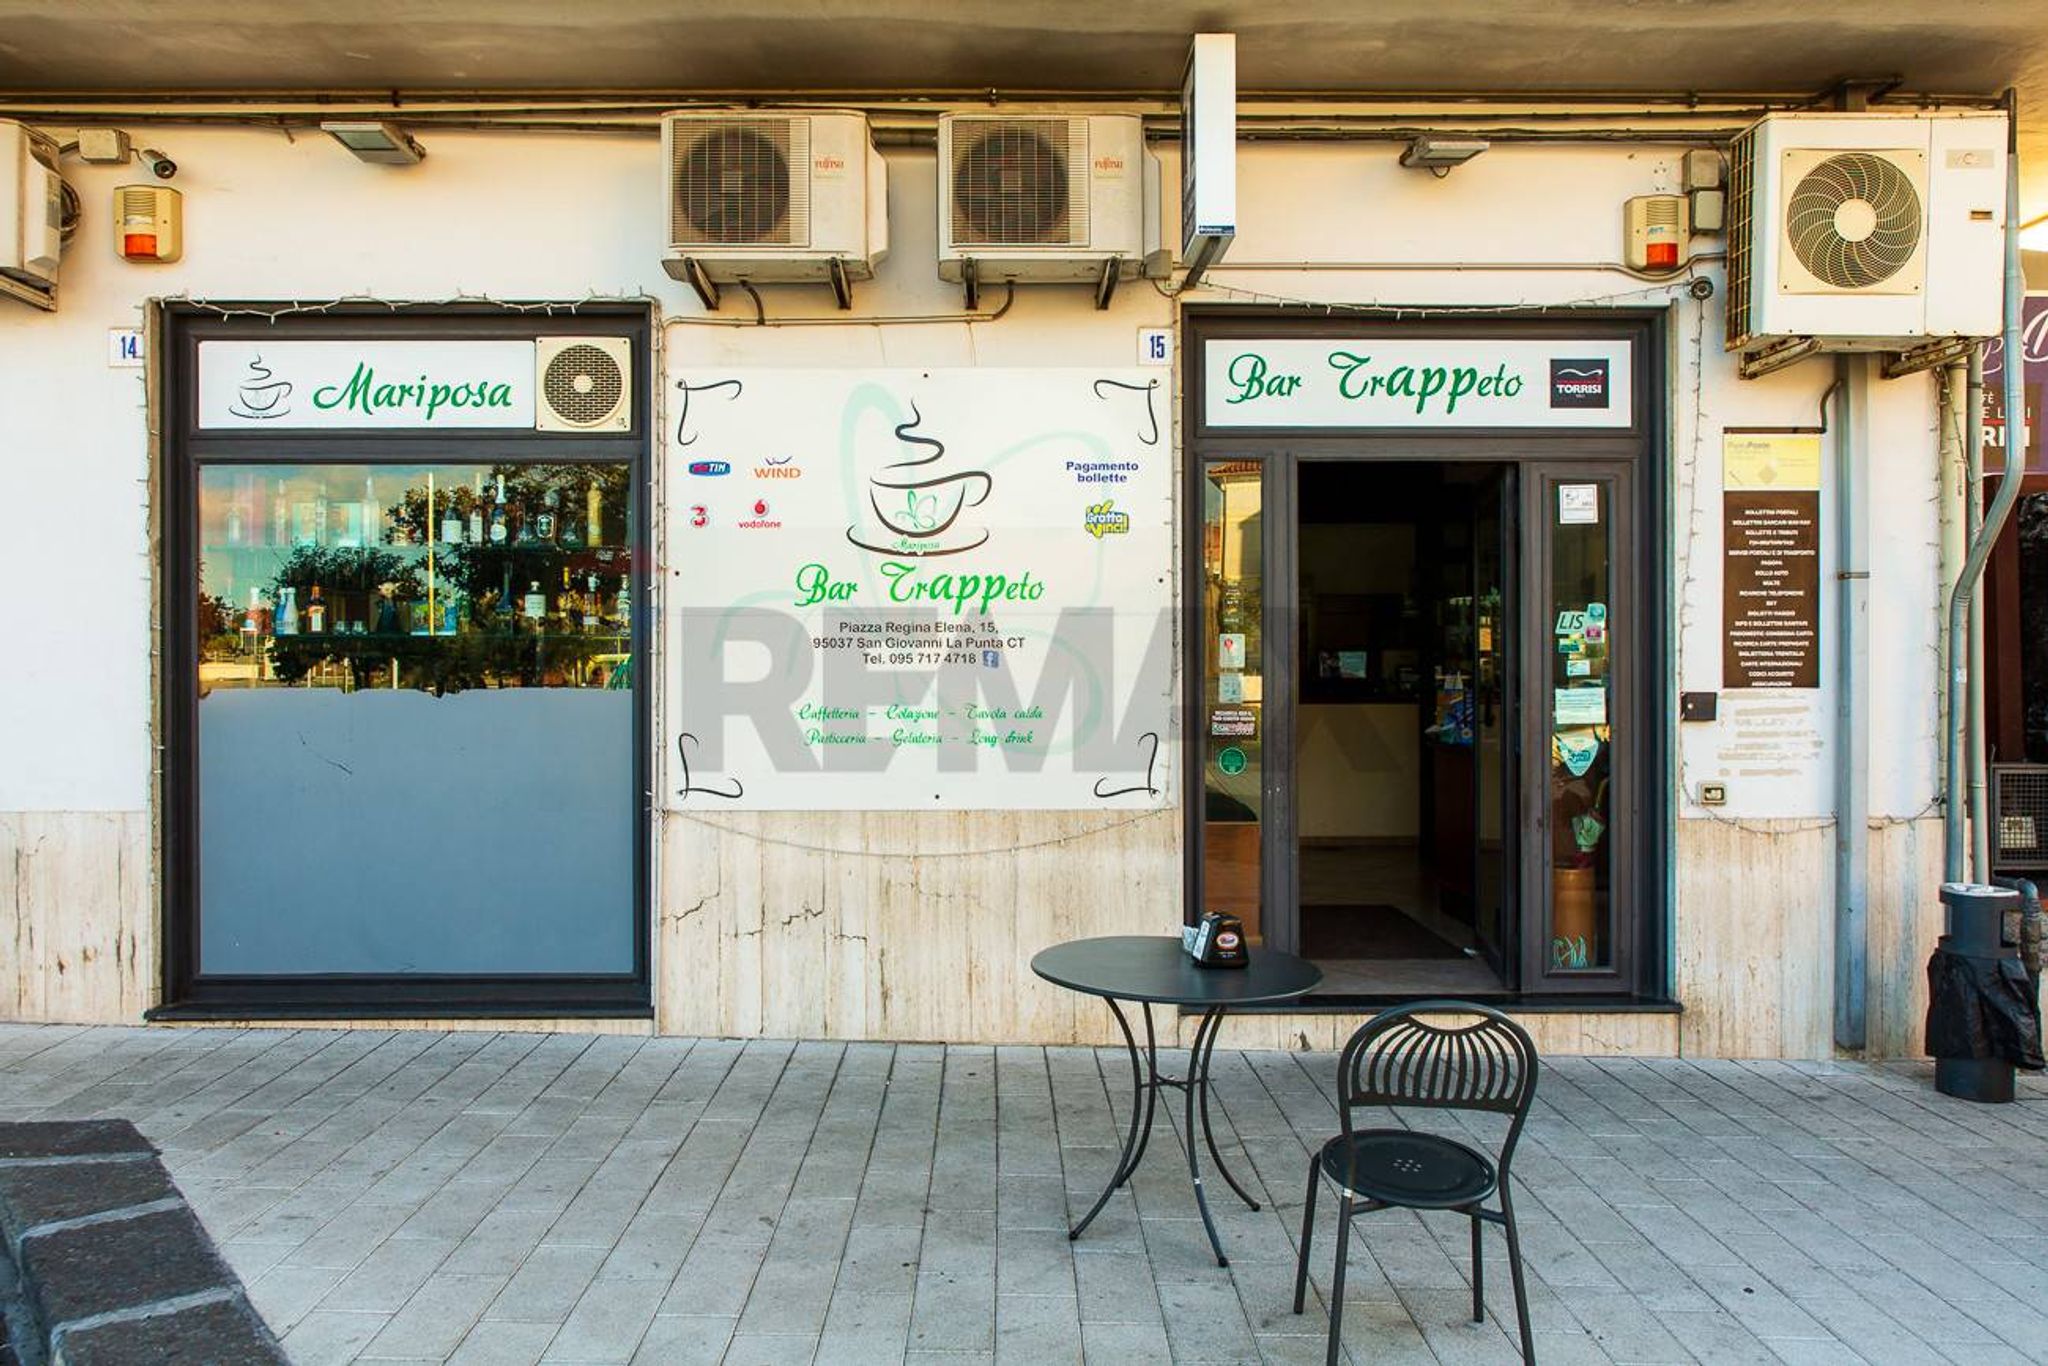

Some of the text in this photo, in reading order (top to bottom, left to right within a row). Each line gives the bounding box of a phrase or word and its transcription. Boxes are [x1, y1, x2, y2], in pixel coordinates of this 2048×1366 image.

[121, 335, 137, 359] 14
[1150, 335, 1165, 358] 15
[1226, 351, 1524, 415] Bar Trappeto
[1556, 384, 1602, 394] TORRISI
[313, 361, 512, 420] Mariposa
[754, 467, 802, 479] WIND
[1066, 461, 1139, 474] Pagamento
[1077, 473, 1127, 483] bollette
[738, 519, 782, 529] vodafone
[795, 562, 1045, 615] Bar Trappeto
[840, 621, 999, 635] Piazza Regina Elena, 15,
[1559, 613, 1585, 630] LIS
[813, 636, 1025, 649] 95037 San Giovanni La Punta CT
[863, 652, 886, 665] Tel.
[889, 652, 914, 665] 095
[918, 652, 941, 665] 717
[944, 652, 977, 665] 4718
[799, 703, 860, 721] Caffetteria
[965, 702, 1007, 720] Tavola
[1014, 705, 1043, 719] calda
